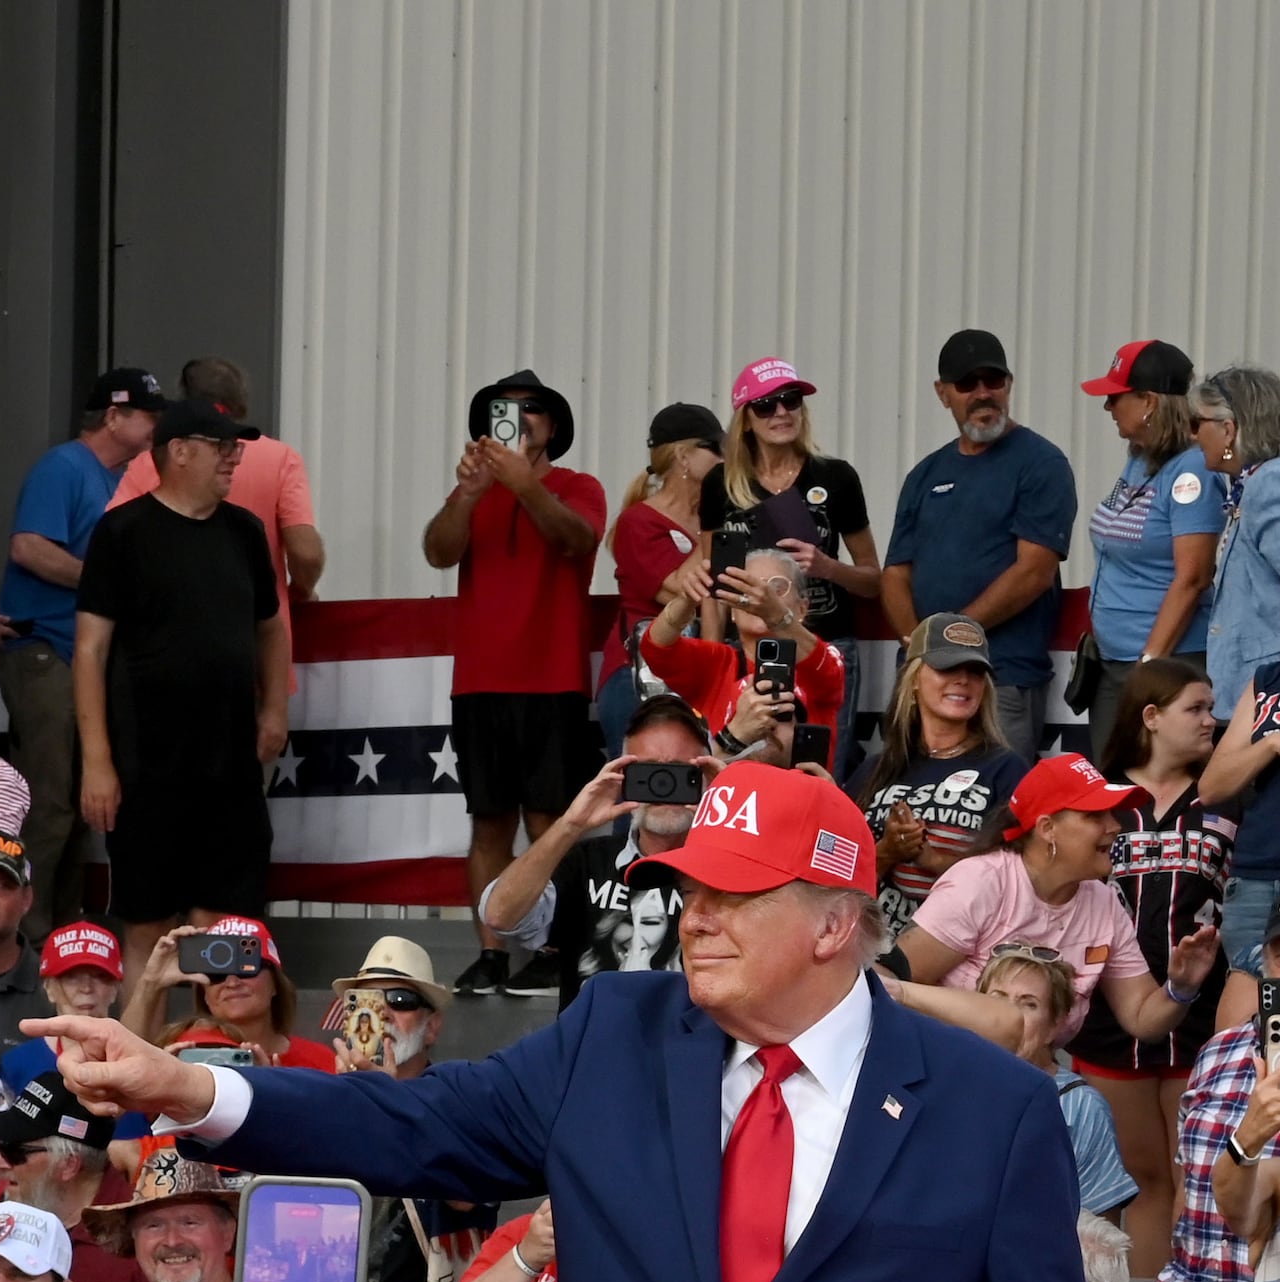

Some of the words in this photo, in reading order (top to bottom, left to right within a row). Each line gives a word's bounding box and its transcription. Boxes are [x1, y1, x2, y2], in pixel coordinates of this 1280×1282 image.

[873, 782, 991, 813] JESUS
[691, 785, 760, 836] USA
[912, 807, 984, 831] SAVIOR
[53, 930, 77, 948] MAKE
[78, 928, 114, 950] AMERICA
[59, 941, 85, 958] GREAT
[86, 942, 110, 959] AGAIN
